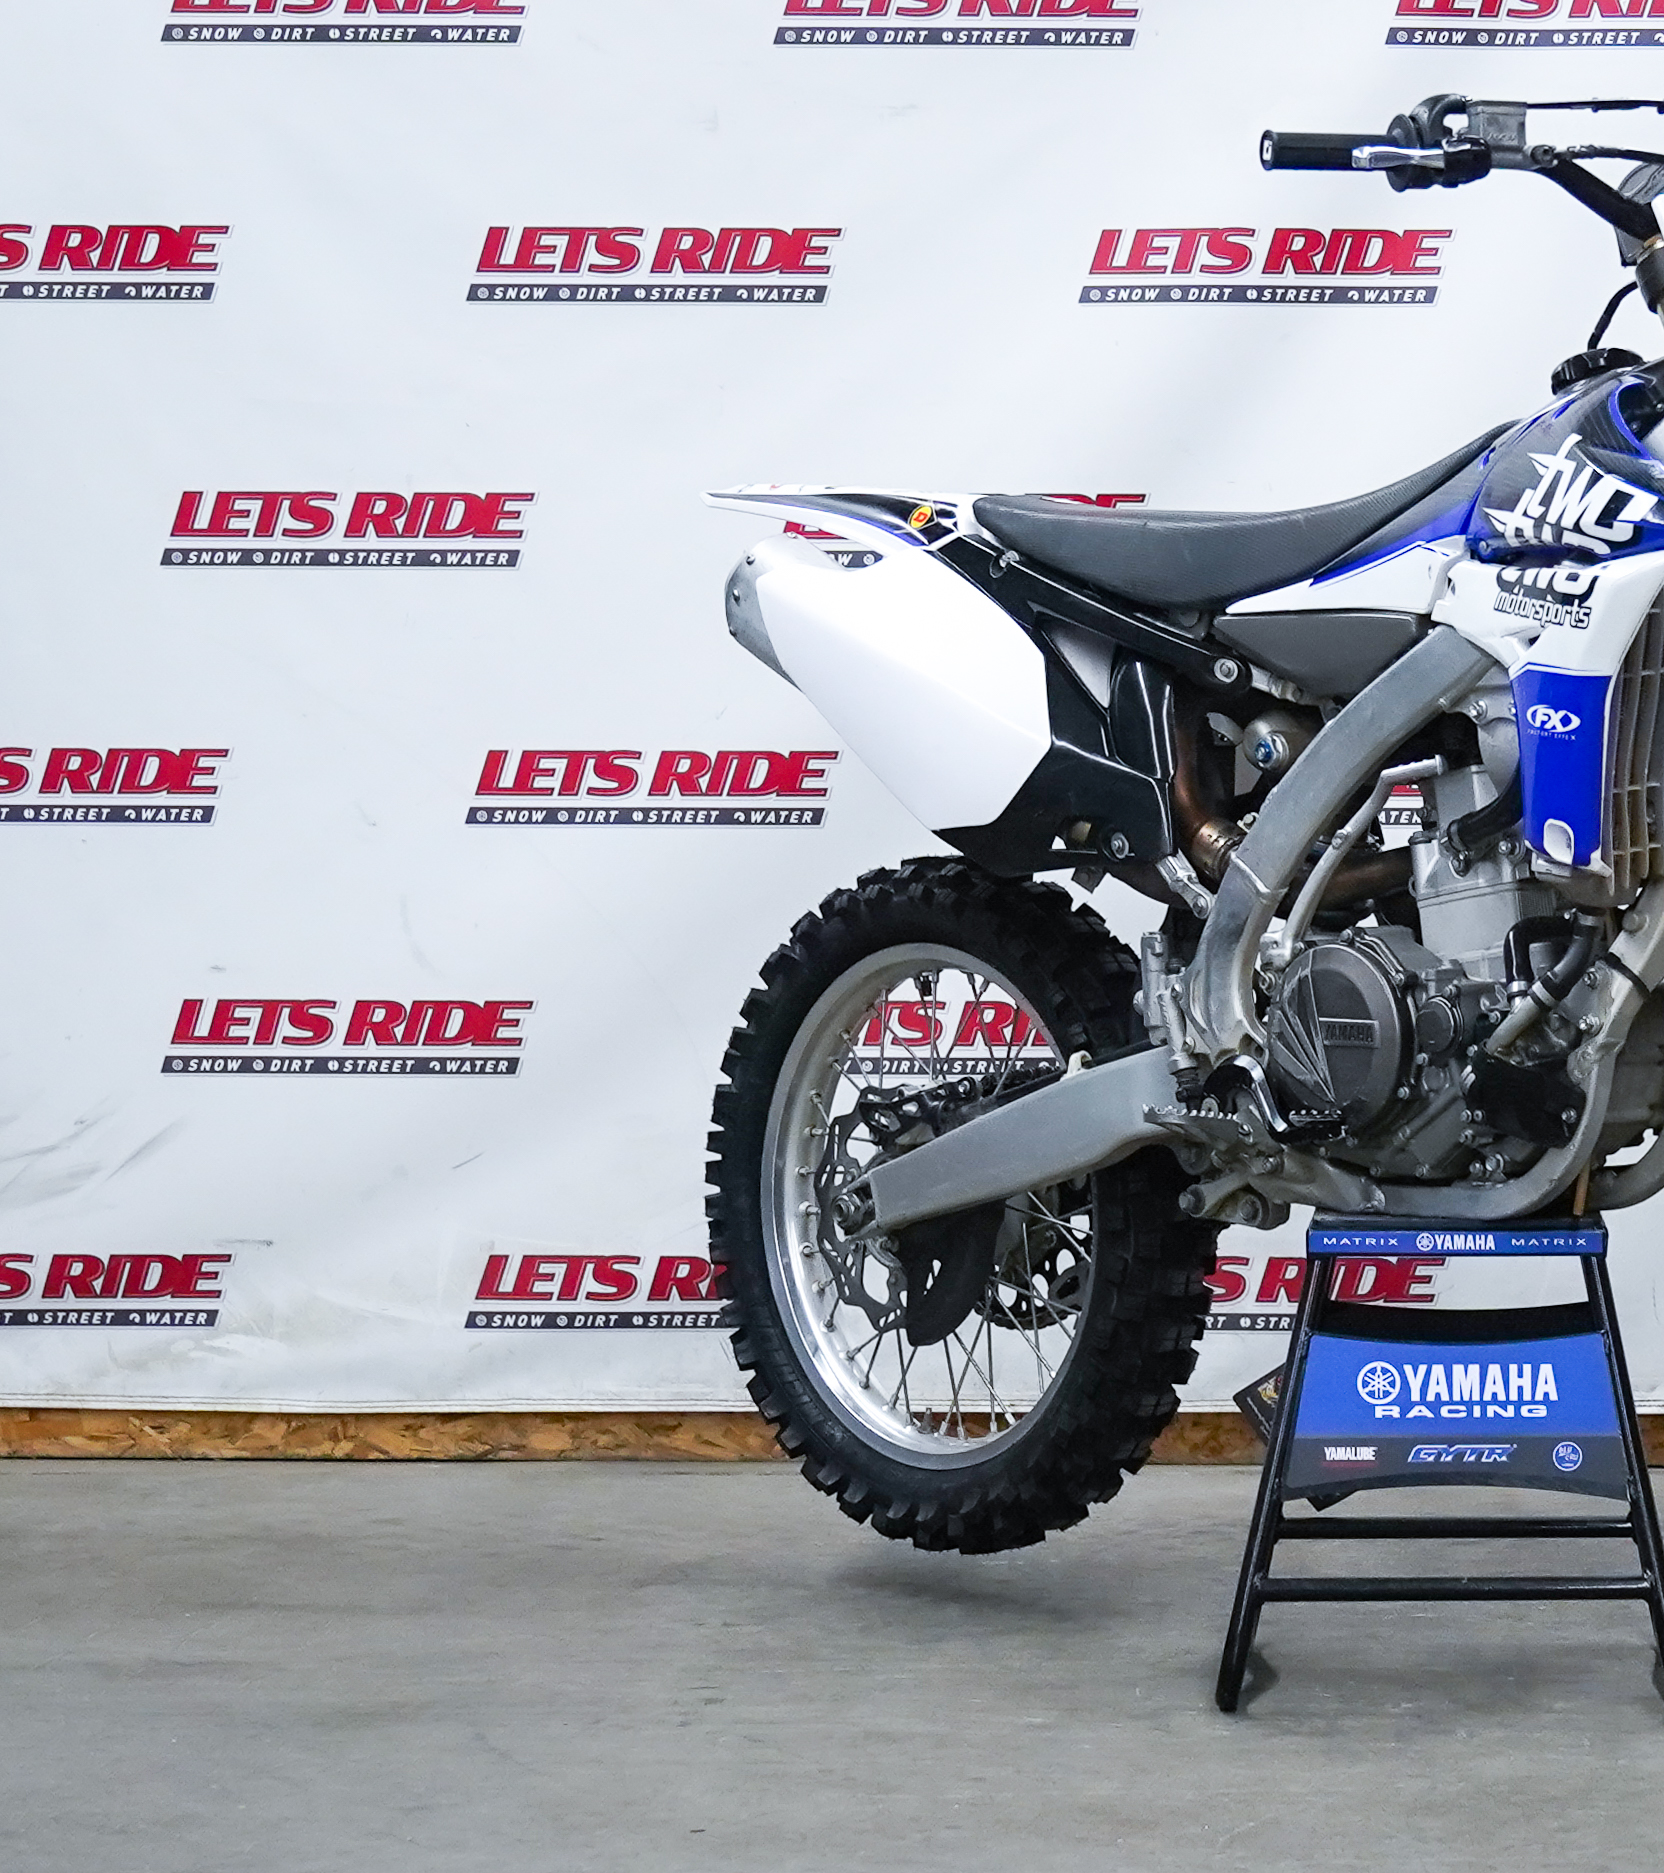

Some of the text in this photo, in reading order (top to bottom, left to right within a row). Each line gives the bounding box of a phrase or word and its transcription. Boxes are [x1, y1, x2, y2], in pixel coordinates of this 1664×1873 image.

[188, 27, 511, 42] SNOW DIRT STREET WATER
[800, 30, 1125, 45] SNOW DIRT STREET WATER
[1412, 31, 1466, 44] SNOW
[1494, 31, 1539, 44] DIRT
[1567, 32, 1640, 45] STREET
[38, 225, 230, 270] RIDE
[476, 226, 841, 274] LETS RIDE
[1089, 228, 1452, 275] LETS RIDE
[38, 285, 204, 298] STREET WATER
[493, 286, 817, 302] SNOW DIRT STREET WATER
[1105, 288, 1428, 302] SNOW DIRT STREET WATER
[170, 491, 534, 538] LETS RIDE
[187, 551, 510, 566] SNOW DIRT STREET WATER
[1494, 585, 1592, 629] motorsports
[38, 748, 230, 794] RIDE
[475, 750, 838, 797] LETS RIDE
[39, 808, 204, 821] STREET WATER
[492, 810, 814, 824] SNOW DIRT STREET WATER
[1378, 810, 1422, 824] ATE
[170, 999, 533, 1046] LETS RIDE
[187, 1058, 509, 1073] SNOW DIRT STREET WATER
[1324, 1234, 1587, 1250] MATRIX YAMAHA MATRIX
[42, 1254, 232, 1298] RIDE
[475, 1254, 641, 1301] LETS
[1255, 1256, 1447, 1304] RDE
[43, 1312, 208, 1324] STREET WATER
[491, 1314, 720, 1327] SNOW DIRT STREET
[1255, 1316, 1295, 1329] STR
[1403, 1364, 1559, 1402] YAMAHA
[1374, 1404, 1548, 1418] RACING
[1324, 1446, 1378, 1461] YAMALUBE
[1407, 1444, 1514, 1462] GYTR
